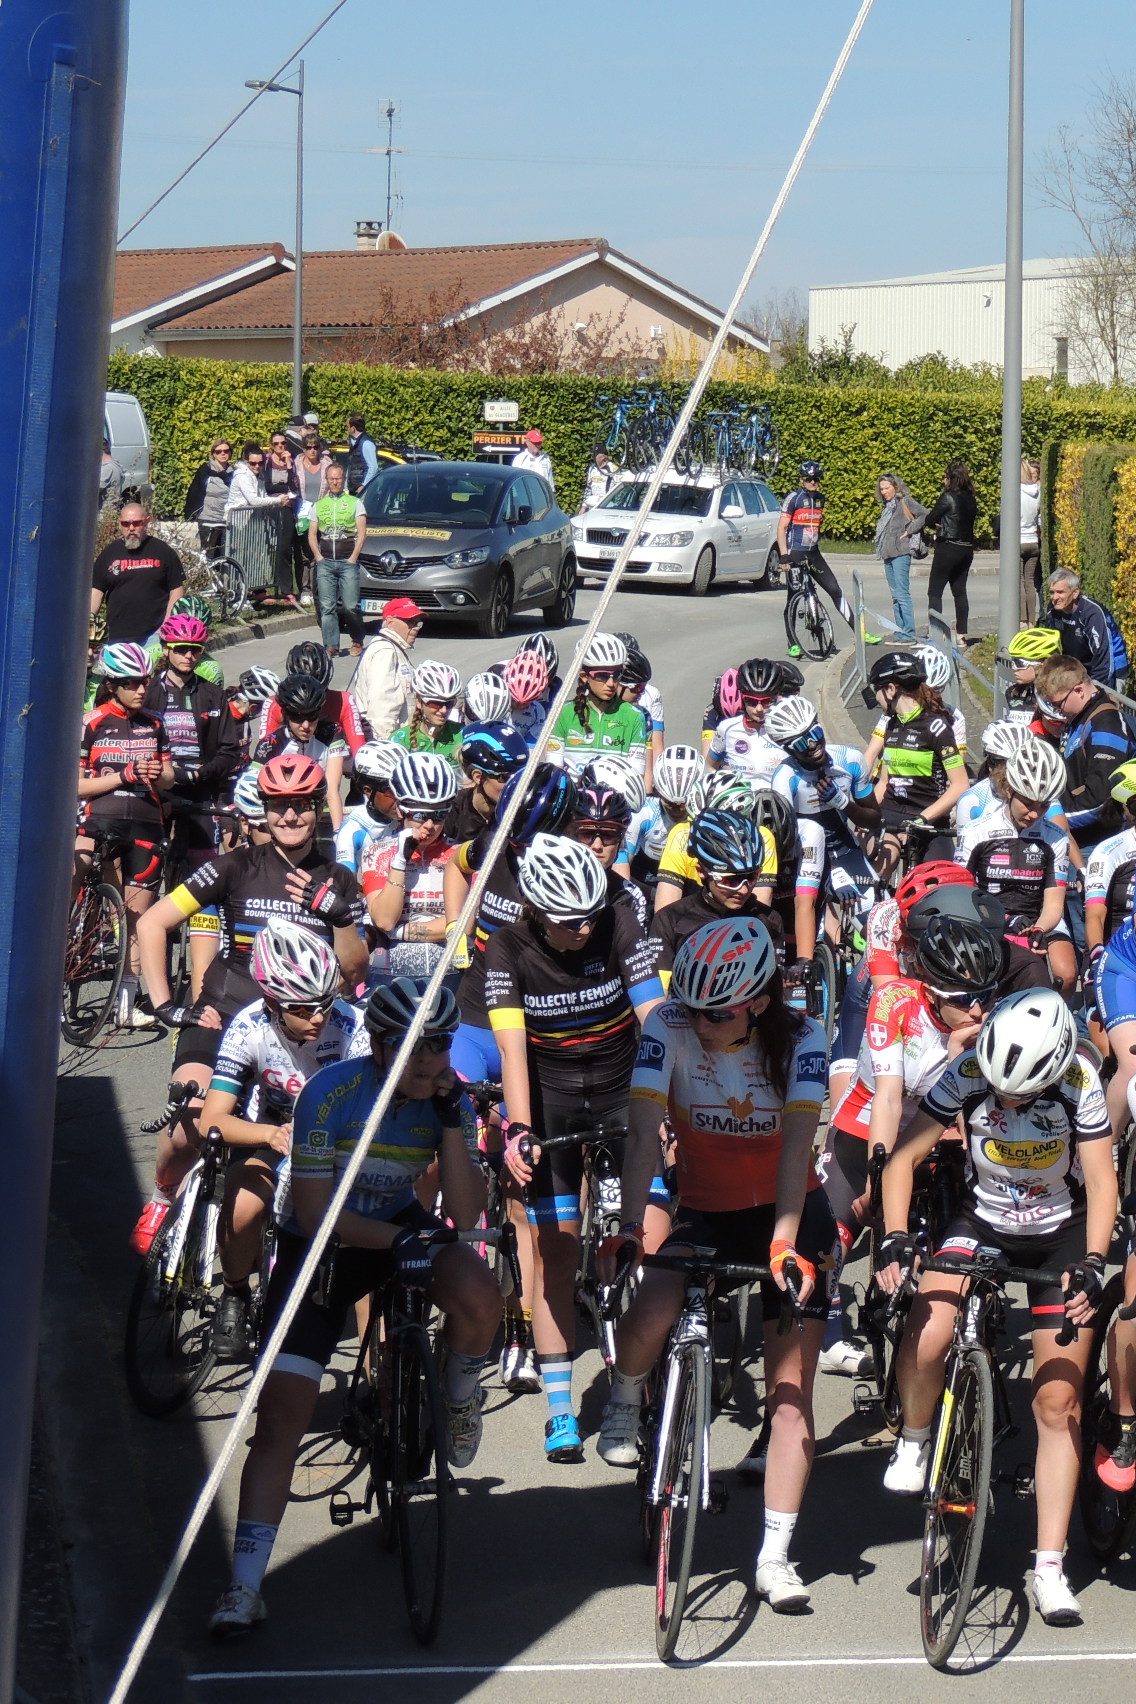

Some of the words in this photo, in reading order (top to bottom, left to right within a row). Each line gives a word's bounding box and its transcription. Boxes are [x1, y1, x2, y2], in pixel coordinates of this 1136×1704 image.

[474, 435, 512, 445] PERRIER
[366, 528, 399, 536] OURSE
[402, 528, 448, 538] CYCLISTE
[930, 718, 947, 737] 01
[524, 989, 578, 1008] COLLECTIF
[579, 976, 622, 1003] FEMININ
[524, 1006, 569, 1018] BOURGOGNE
[570, 999, 605, 1014] FRANCHE
[993, 1138, 1058, 1157] VELOLAND
[406, 1259, 432, 1269] FRANCE
[958, 1449, 973, 1480] BMC
